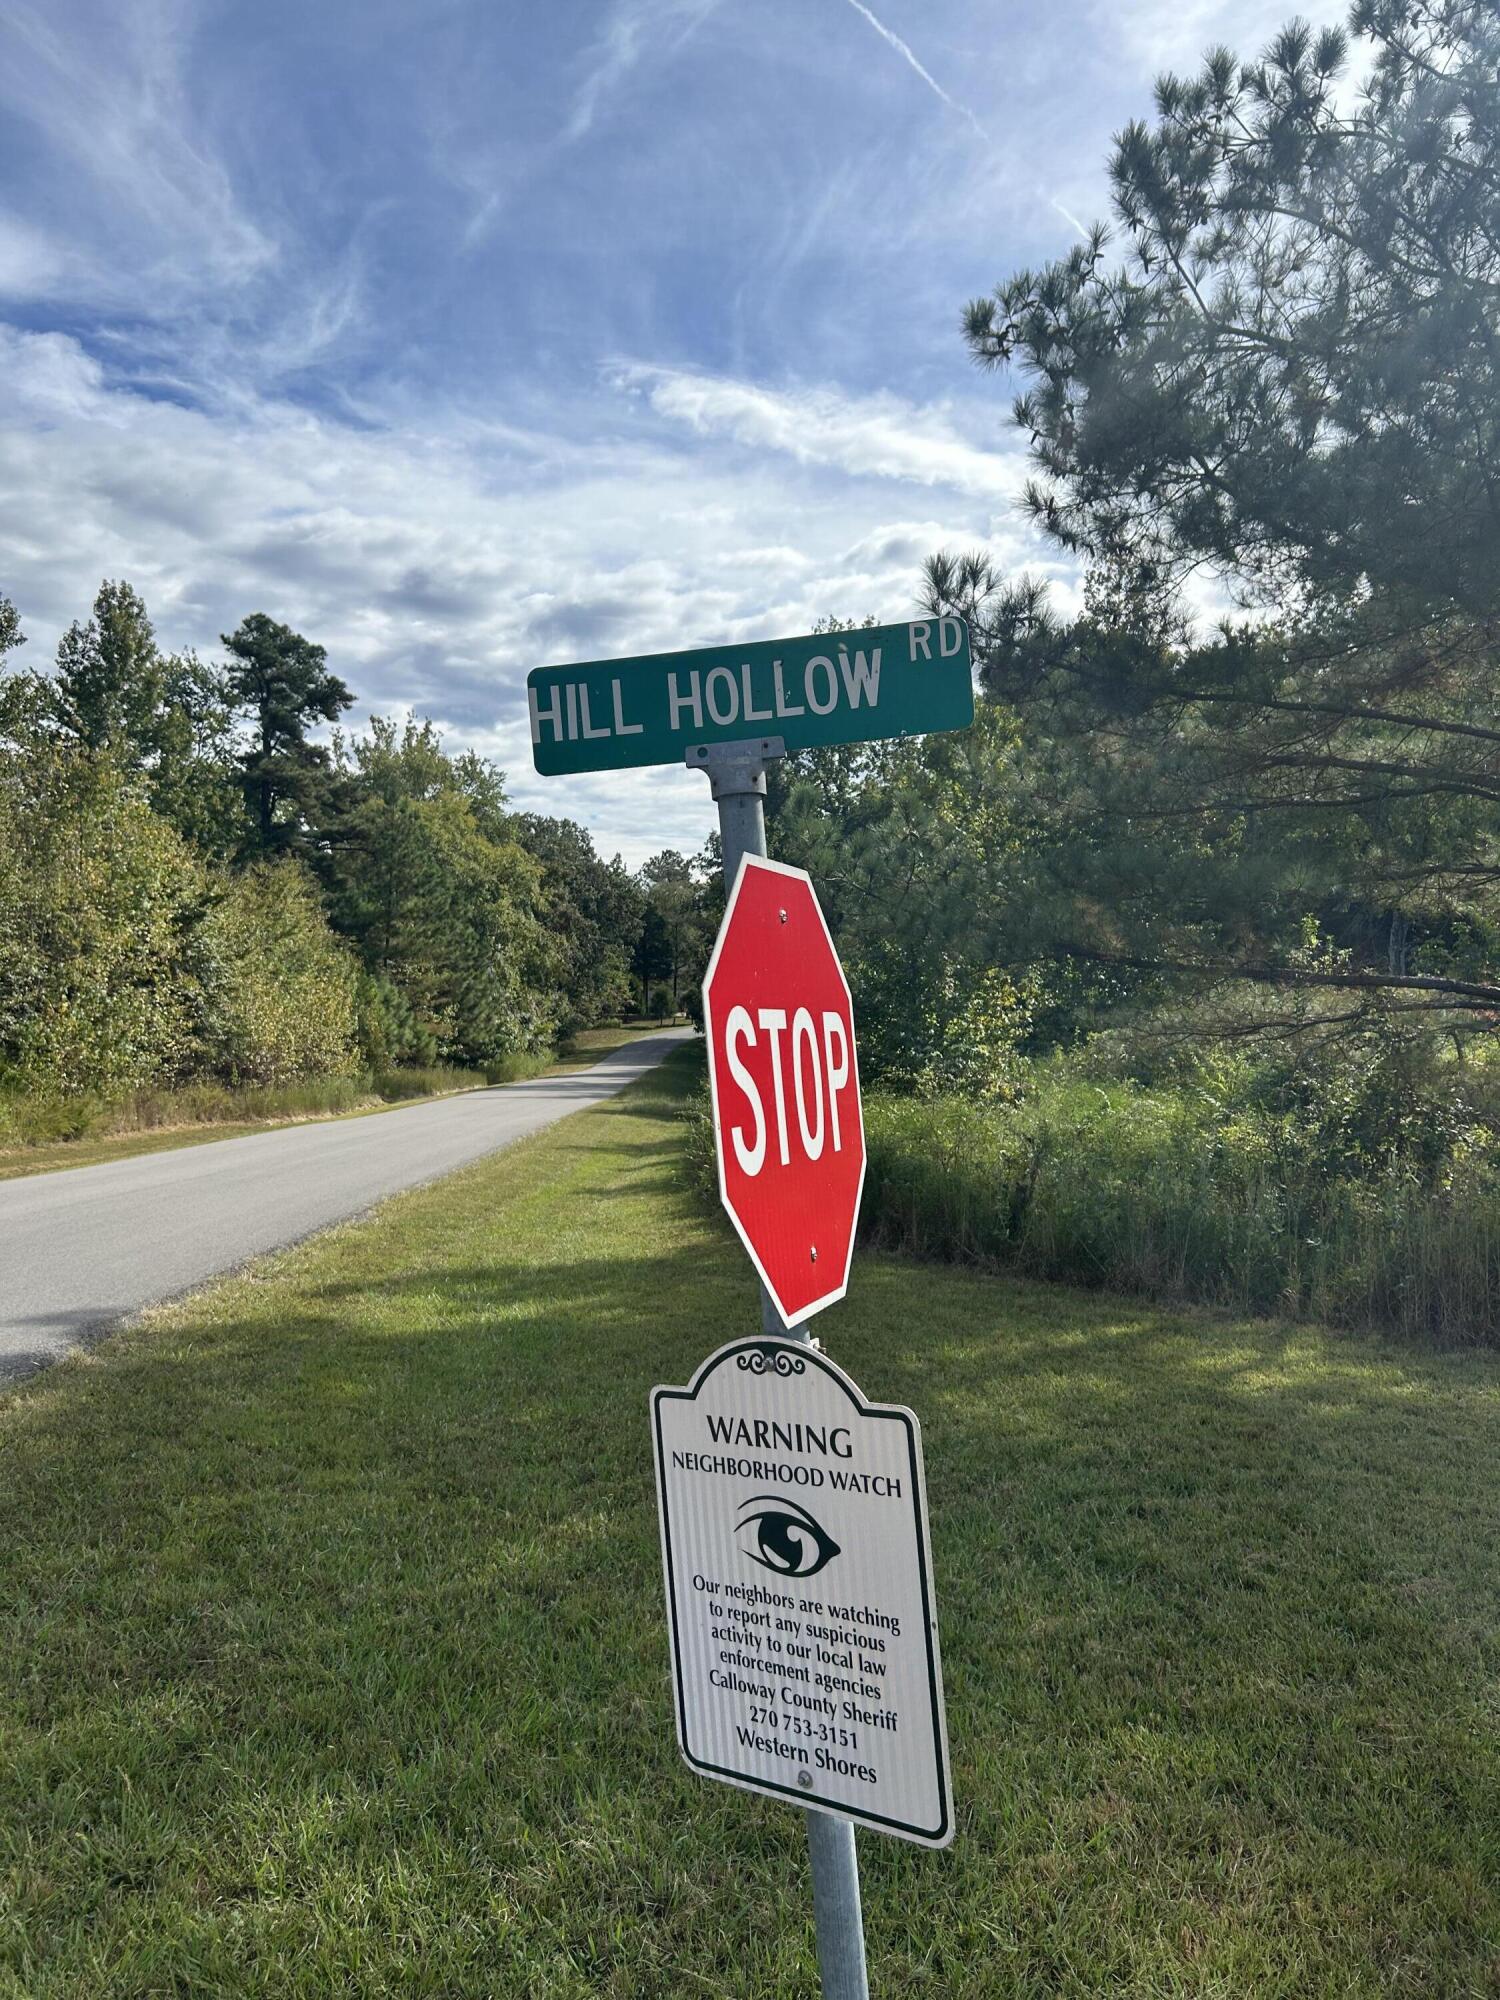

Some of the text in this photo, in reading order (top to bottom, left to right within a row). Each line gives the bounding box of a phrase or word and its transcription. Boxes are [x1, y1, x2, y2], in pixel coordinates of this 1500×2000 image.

[528, 616, 962, 744] HILL HOLLOW RD
[725, 1005, 849, 1176] STOP
[706, 1415, 852, 1458] WARNING
[673, 1451, 901, 1498] NEIGHBORHOOD WATCH
[693, 1575, 901, 1636] Our neighbors are watching
[710, 1601, 885, 1652] to report any suspicious
[711, 1624, 886, 1677] activity to our local law
[720, 1649, 881, 1700] enforcement agencies
[710, 1669, 898, 1731] Calloway County Sheriff
[750, 1706, 857, 1749] 270 753-3151
[736, 1726, 877, 1784] Western Shores
